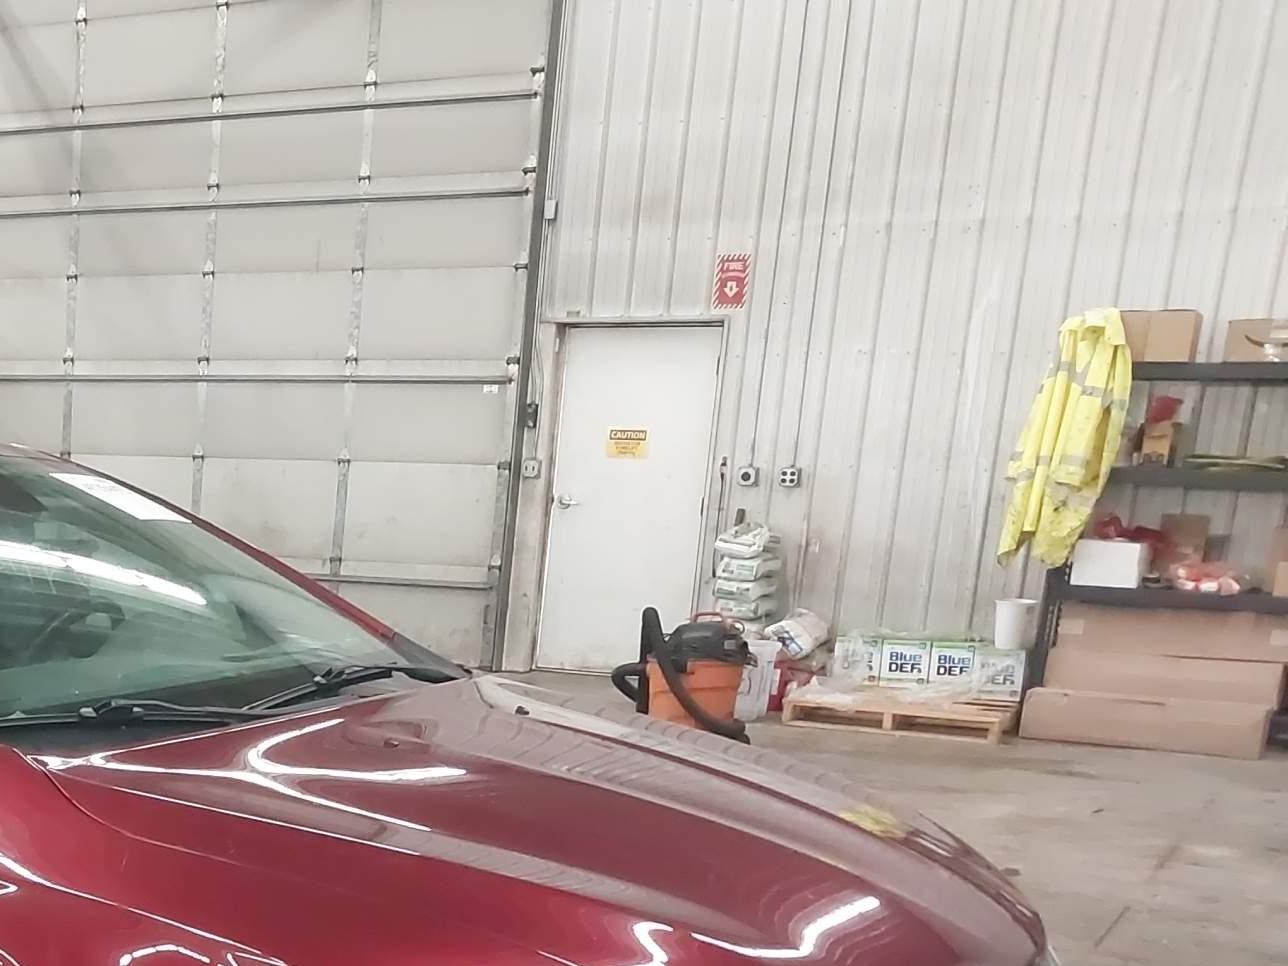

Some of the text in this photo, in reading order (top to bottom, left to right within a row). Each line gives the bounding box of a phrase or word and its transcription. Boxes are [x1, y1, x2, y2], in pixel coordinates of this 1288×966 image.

[611, 431, 646, 440] CAUTION
[889, 651, 922, 663] Blue
[937, 654, 971, 666] Blue
[888, 661, 922, 674] DEF
[936, 665, 970, 677] DEF
[984, 674, 1015, 686] EF
